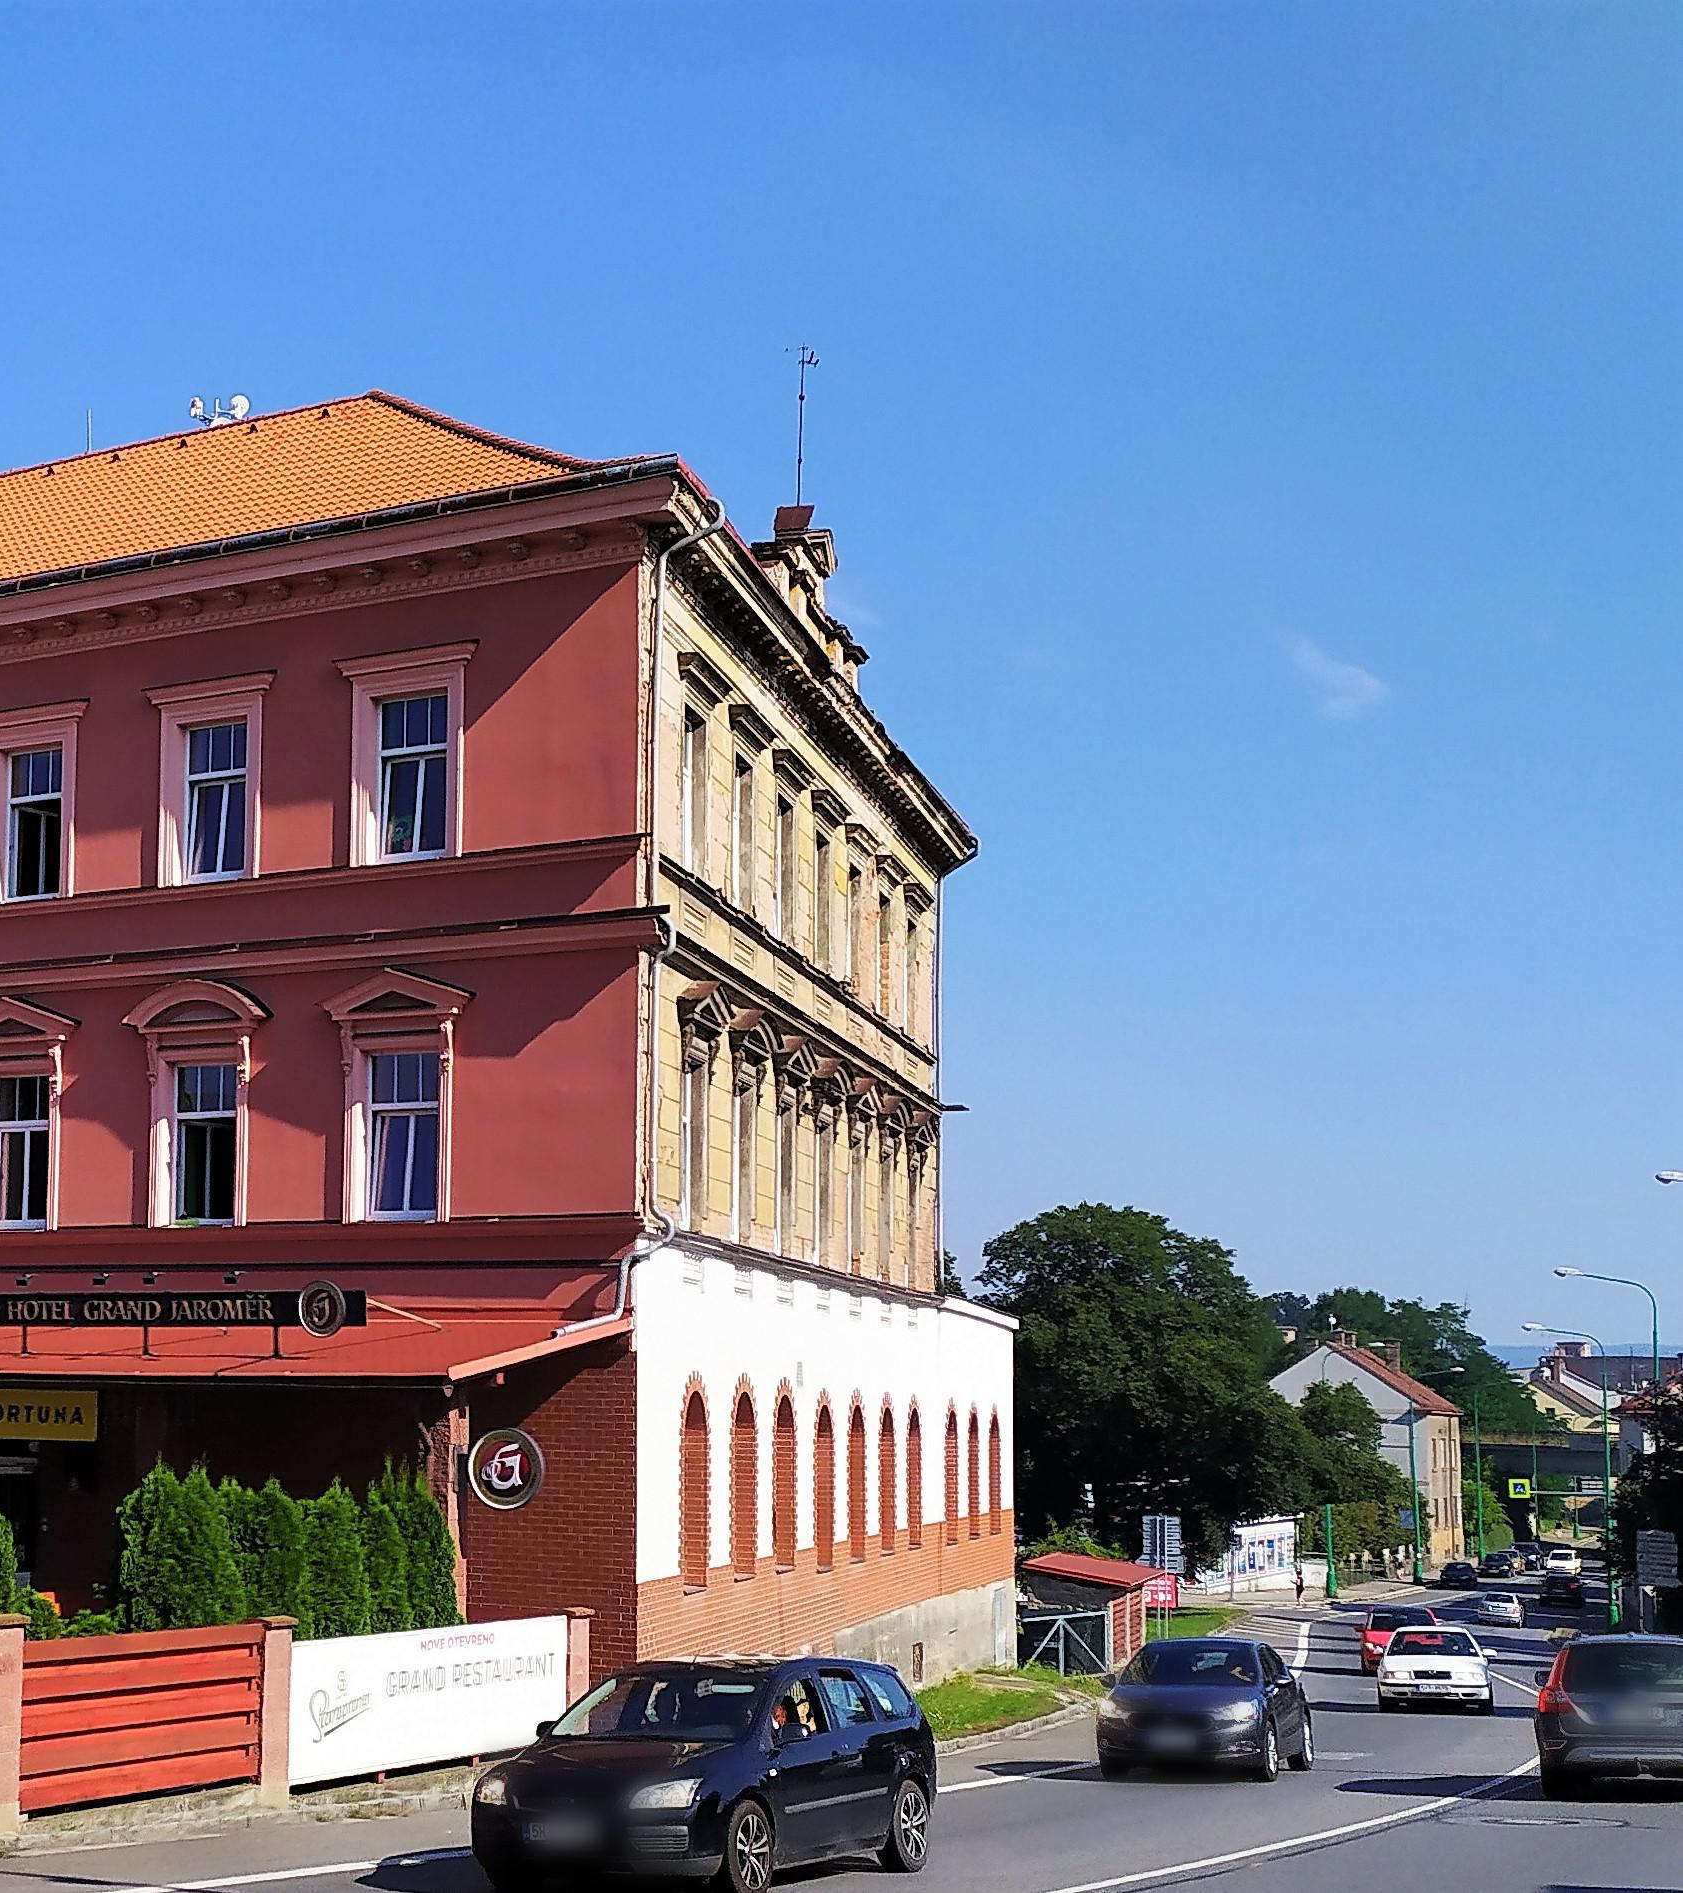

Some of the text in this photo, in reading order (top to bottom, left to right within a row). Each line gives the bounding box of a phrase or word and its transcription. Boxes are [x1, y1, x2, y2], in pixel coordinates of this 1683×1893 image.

[7, 1293, 274, 1321] HOTEL GRAND JAROMĚŘ
[386, 1652, 555, 1697] GRAND RESTAURANT
